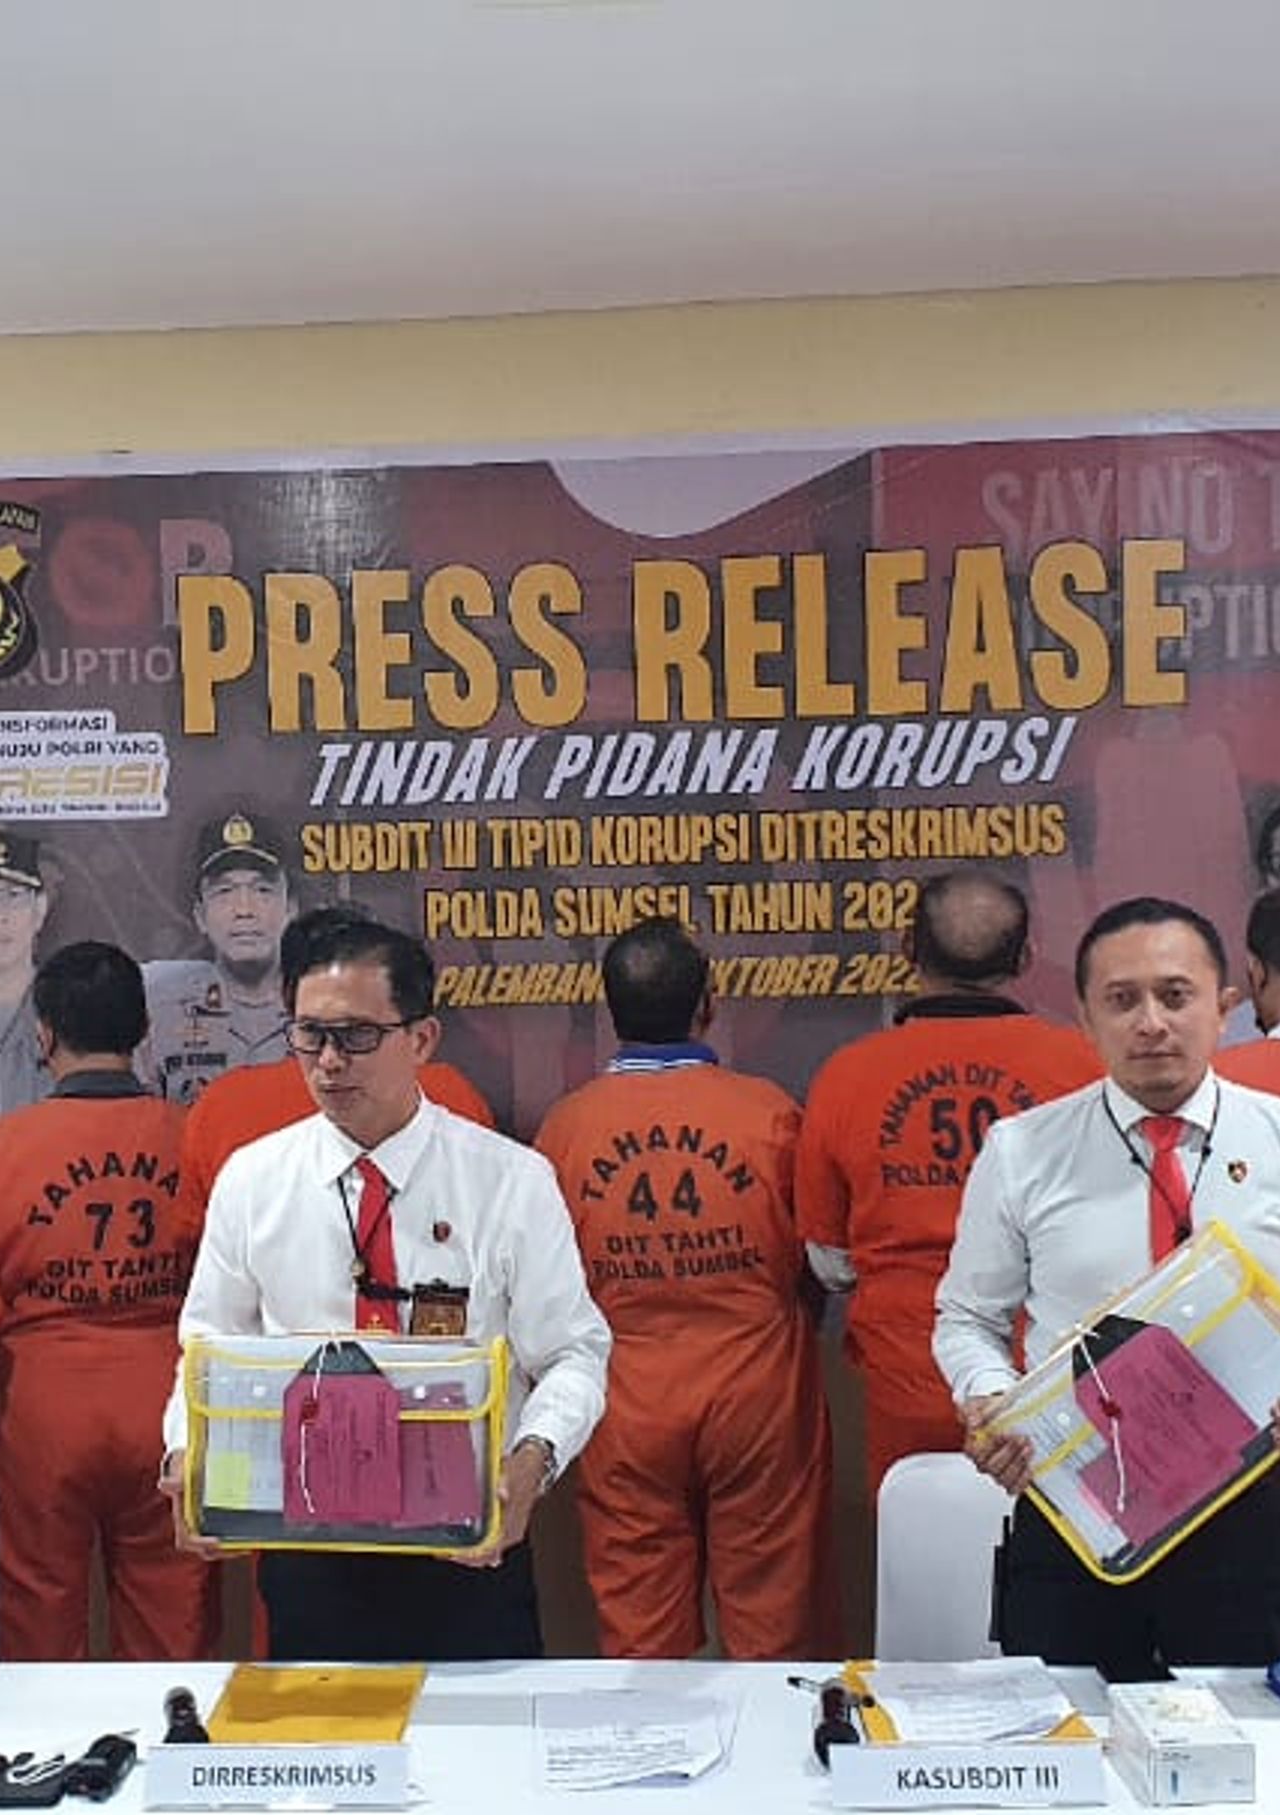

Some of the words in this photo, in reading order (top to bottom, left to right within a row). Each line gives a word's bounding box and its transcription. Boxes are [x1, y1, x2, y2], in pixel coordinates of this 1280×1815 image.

[1137, 456, 1233, 554] NO
[178, 562, 588, 734] PRESS
[631, 538, 1188, 723] RELEASE
[309, 734, 539, 807] TINDAK
[543, 728, 779, 800] PIDANA
[791, 716, 1078, 791] KORUPSI
[301, 820, 432, 873] SUBDIT
[442, 819, 478, 870] III
[487, 817, 582, 870] TIPID
[590, 811, 750, 867] KORUPSI
[760, 803, 1066, 862] DITRESKRIMSUS
[425, 887, 544, 940] POLDA
[707, 881, 834, 934] TAHUN
[843, 880, 918, 930] 202
[433, 960, 605, 1006] PALEMBAN
[708, 953, 841, 1001] KTOBER
[27, 1151, 181, 1227] TAHANA
[580, 1124, 756, 1201] TAHANAN
[881, 1163, 959, 1188] POLDA
[627, 1167, 702, 1222] 44
[84, 1198, 155, 1251] 73
[606, 1235, 651, 1255] DIT
[660, 1224, 745, 1254] TAHTI
[46, 1257, 95, 1279] DIT
[102, 1250, 181, 1280] TAHTI
[192, 1763, 378, 1789] DIRRESKRIMSUS
[896, 1766, 1028, 1792] KASUBDIT
[1034, 1766, 1060, 1791] III
